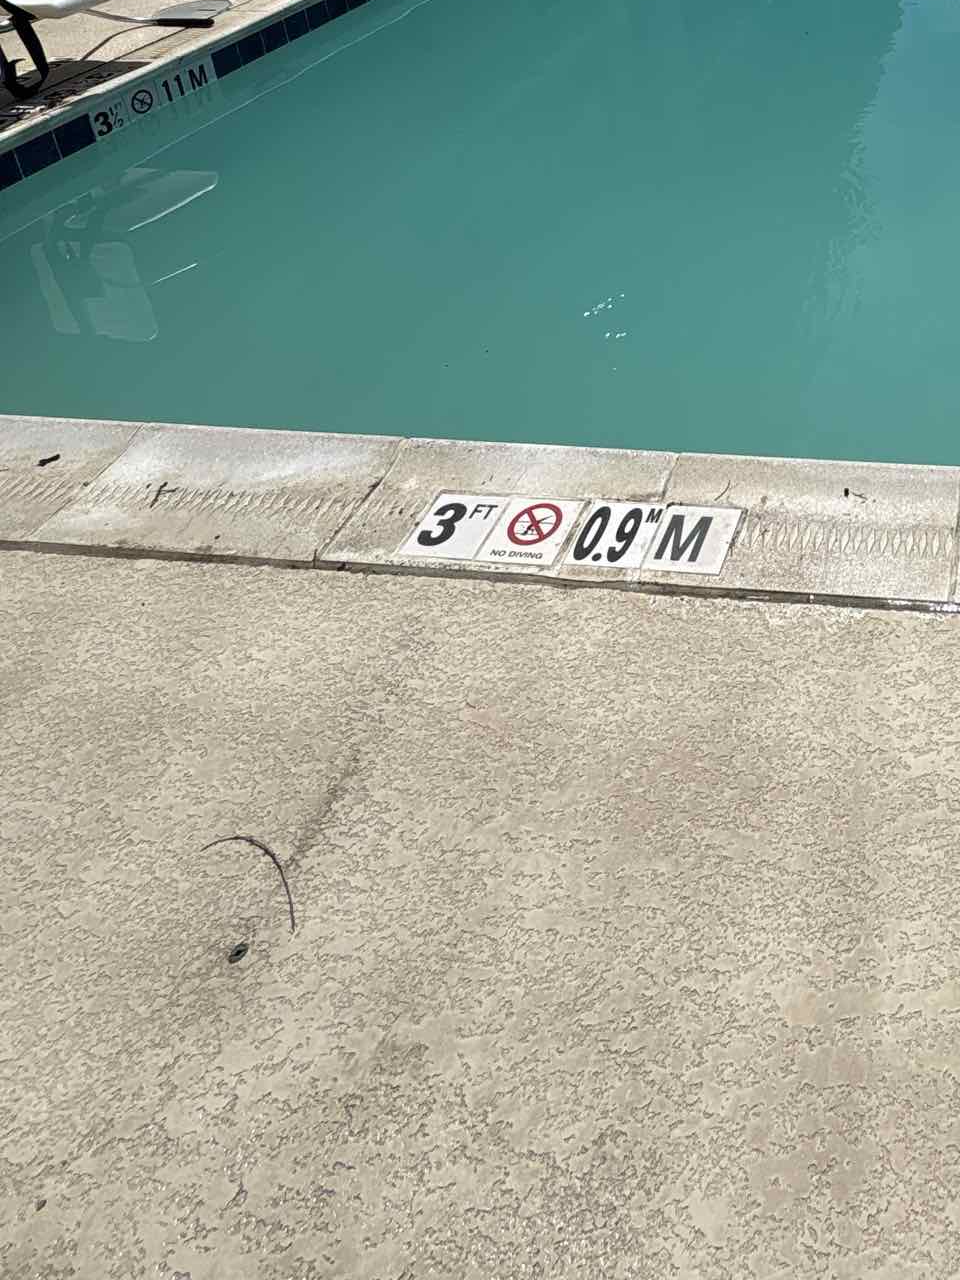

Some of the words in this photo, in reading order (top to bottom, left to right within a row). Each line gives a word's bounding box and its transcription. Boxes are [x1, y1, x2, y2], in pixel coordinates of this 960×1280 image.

[417, 503, 467, 547] 3
[468, 503, 498, 520] FT
[573, 506, 643, 563] 0.9
[645, 508, 663, 524] M
[490, 549, 507, 558] NO
[508, 550, 544, 560] DIVING
[653, 514, 713, 563] M
